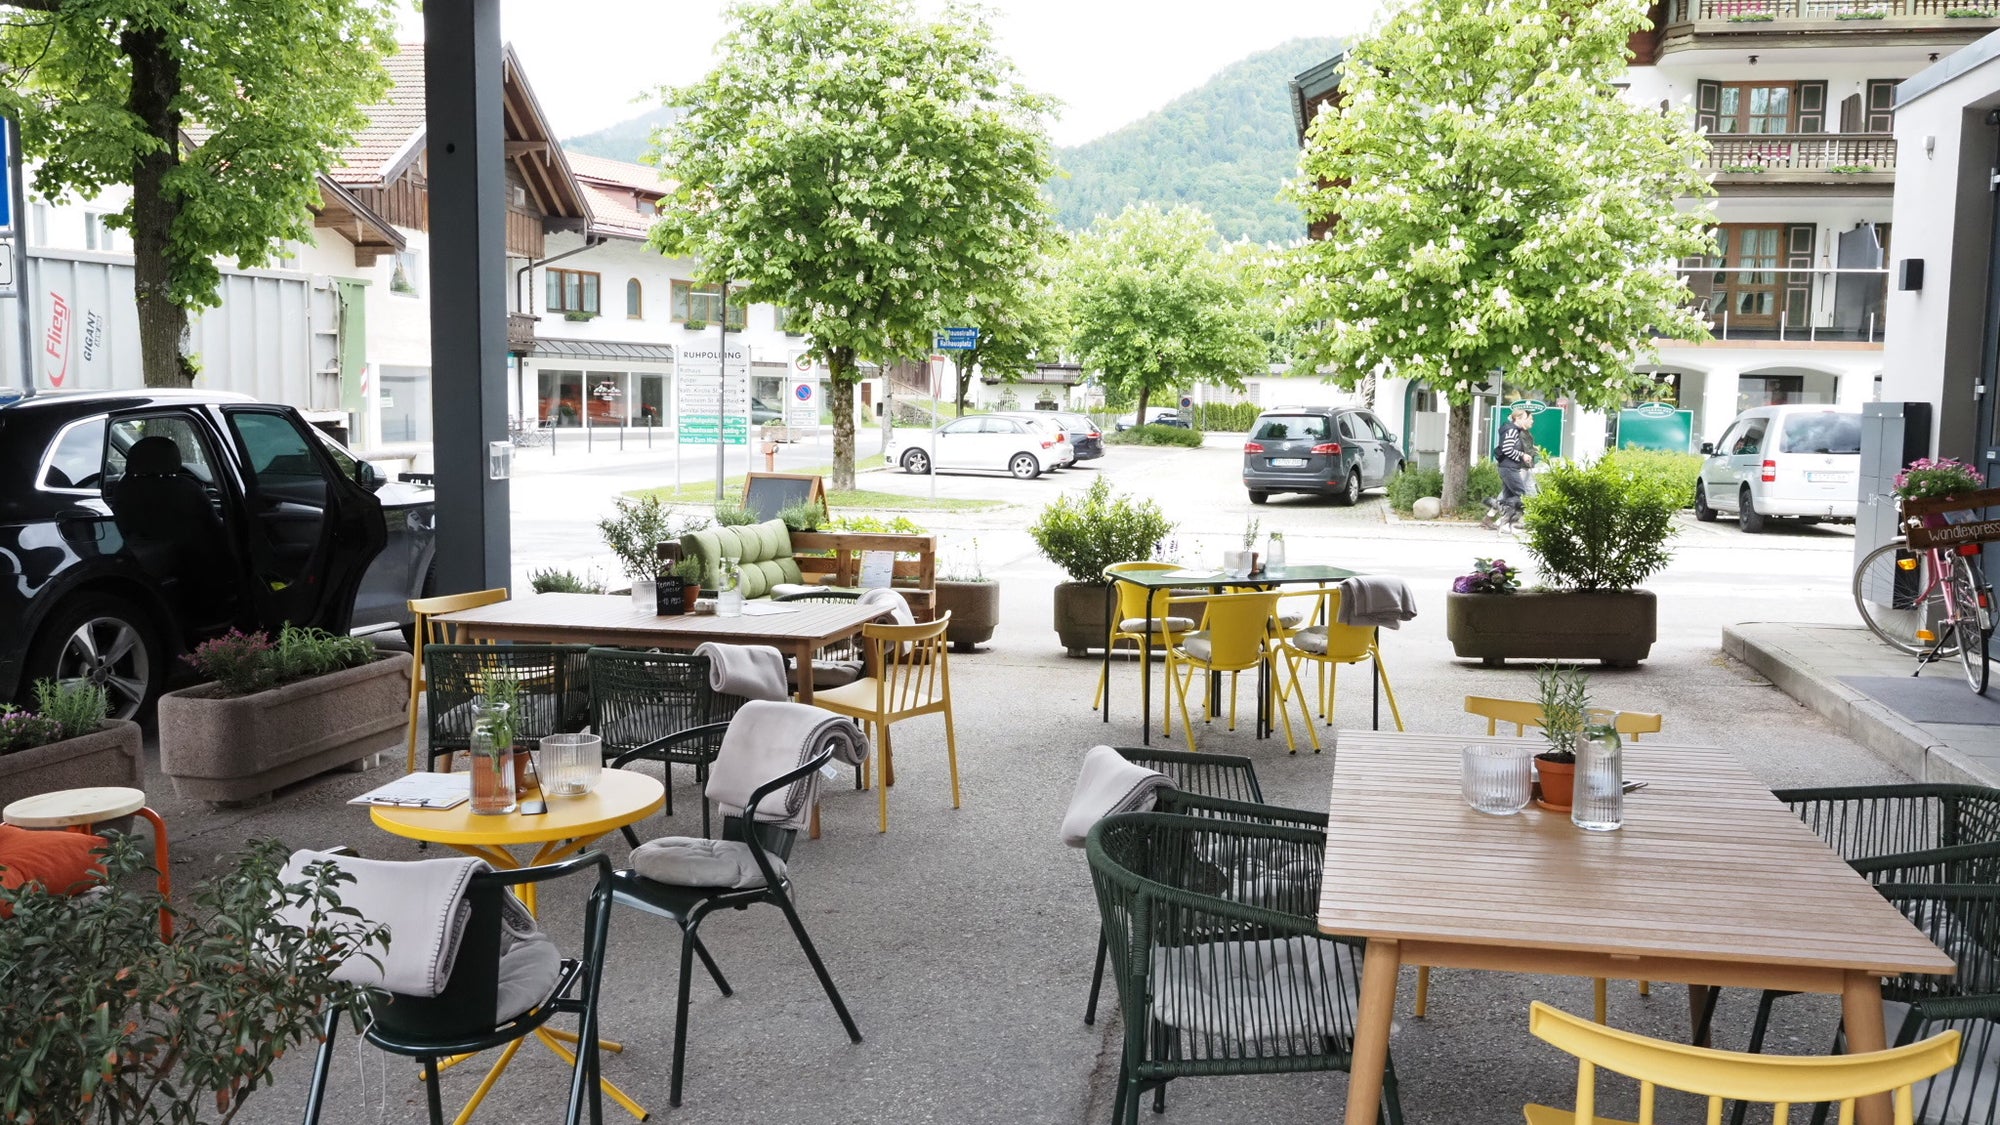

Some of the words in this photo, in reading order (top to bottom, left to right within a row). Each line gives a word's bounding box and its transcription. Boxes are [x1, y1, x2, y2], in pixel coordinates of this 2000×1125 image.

[46, 291, 68, 359] Fliegl
[83, 309, 96, 361] GIGANT
[683, 351, 742, 360] RUHPOLING
